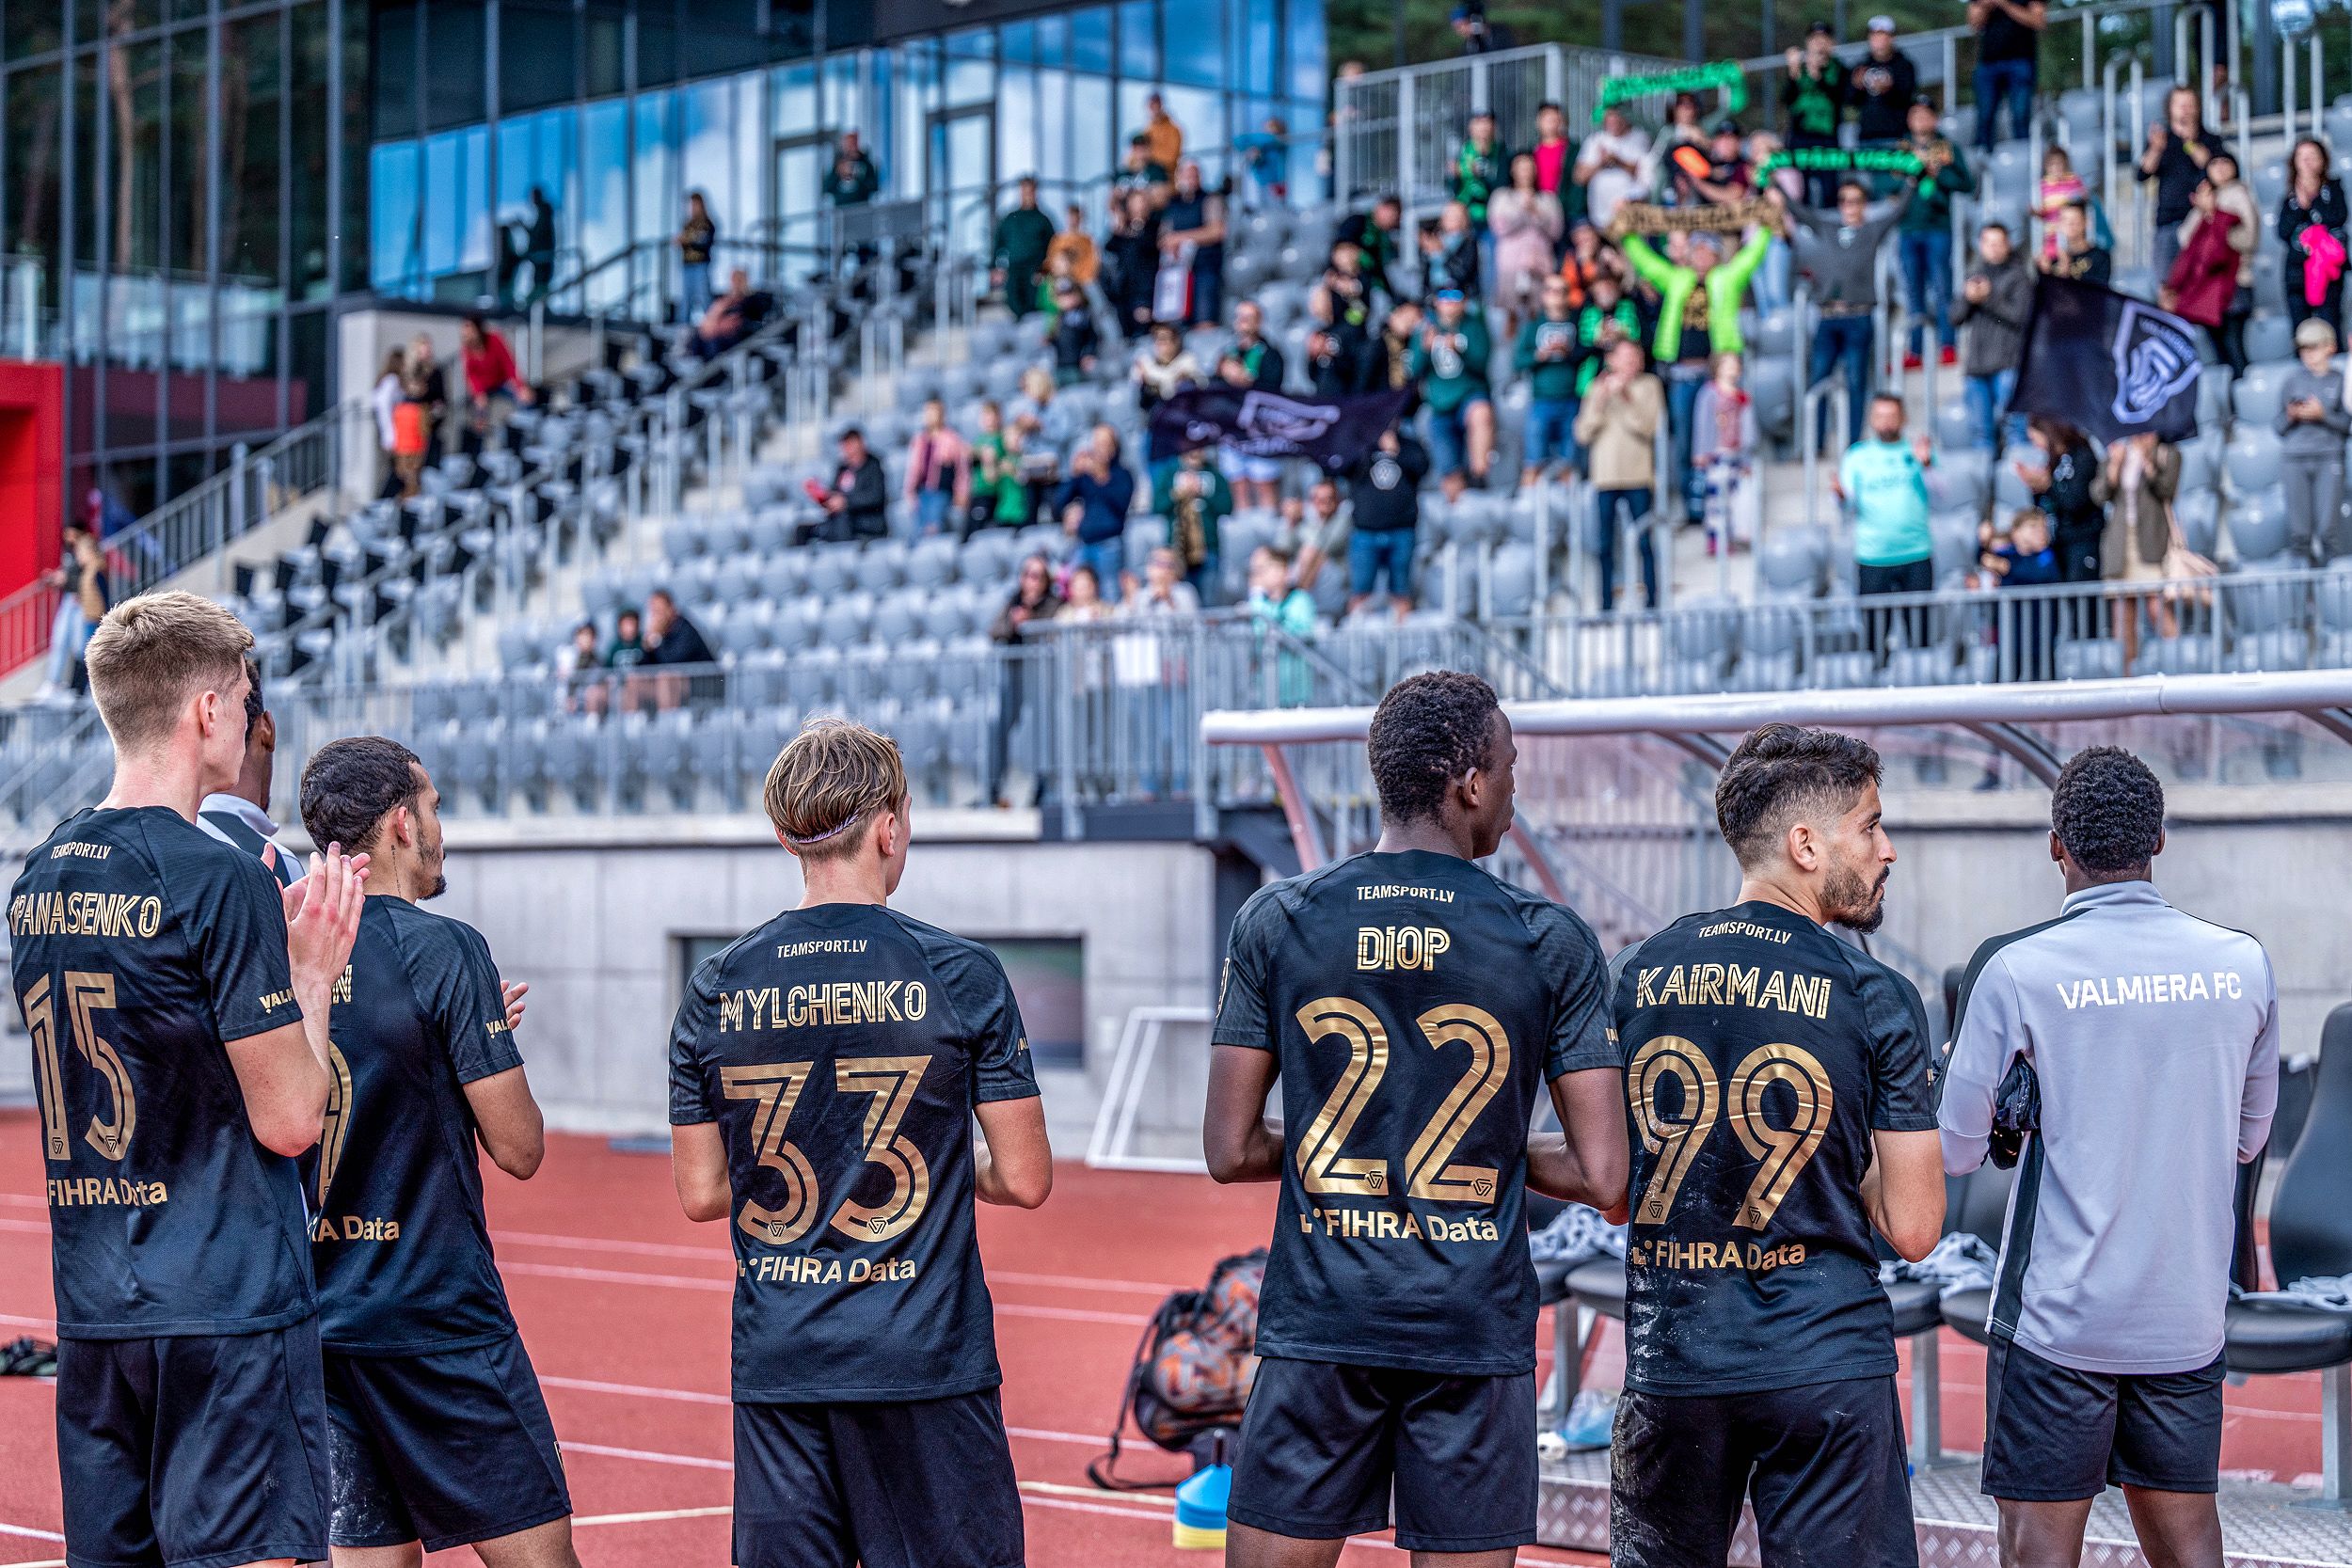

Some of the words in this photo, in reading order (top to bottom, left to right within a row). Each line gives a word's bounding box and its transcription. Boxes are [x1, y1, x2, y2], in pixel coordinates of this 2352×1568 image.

[1357, 884, 1455, 903] TEAMSPORT.LV
[777, 940, 867, 958] TEAMSPORT.LV
[1357, 926, 1451, 971] DIOP
[1698, 921, 1791, 944] TEAMSPORT.LV
[720, 980, 927, 1033] MYLCHENKO
[1636, 962, 1832, 1020] KAIRMANI
[2056, 972, 2209, 1009] VALMIERA
[2213, 972, 2242, 1000] FC
[23, 971, 136, 1162] 15
[1295, 996, 1511, 1205] 22
[720, 1054, 932, 1245] 33
[1629, 1035, 1834, 1231] 99
[48, 1178, 120, 1206] FIHRA
[119, 1178, 167, 1206] Data
[342, 1215, 400, 1241] Data
[1324, 1209, 1423, 1240] FIHRA
[1425, 1214, 1499, 1242] Data
[756, 1256, 842, 1284] FIHRA
[848, 1257, 916, 1283] Data
[1656, 1240, 1743, 1270] FIHRA
[1746, 1243, 1805, 1271] Data
